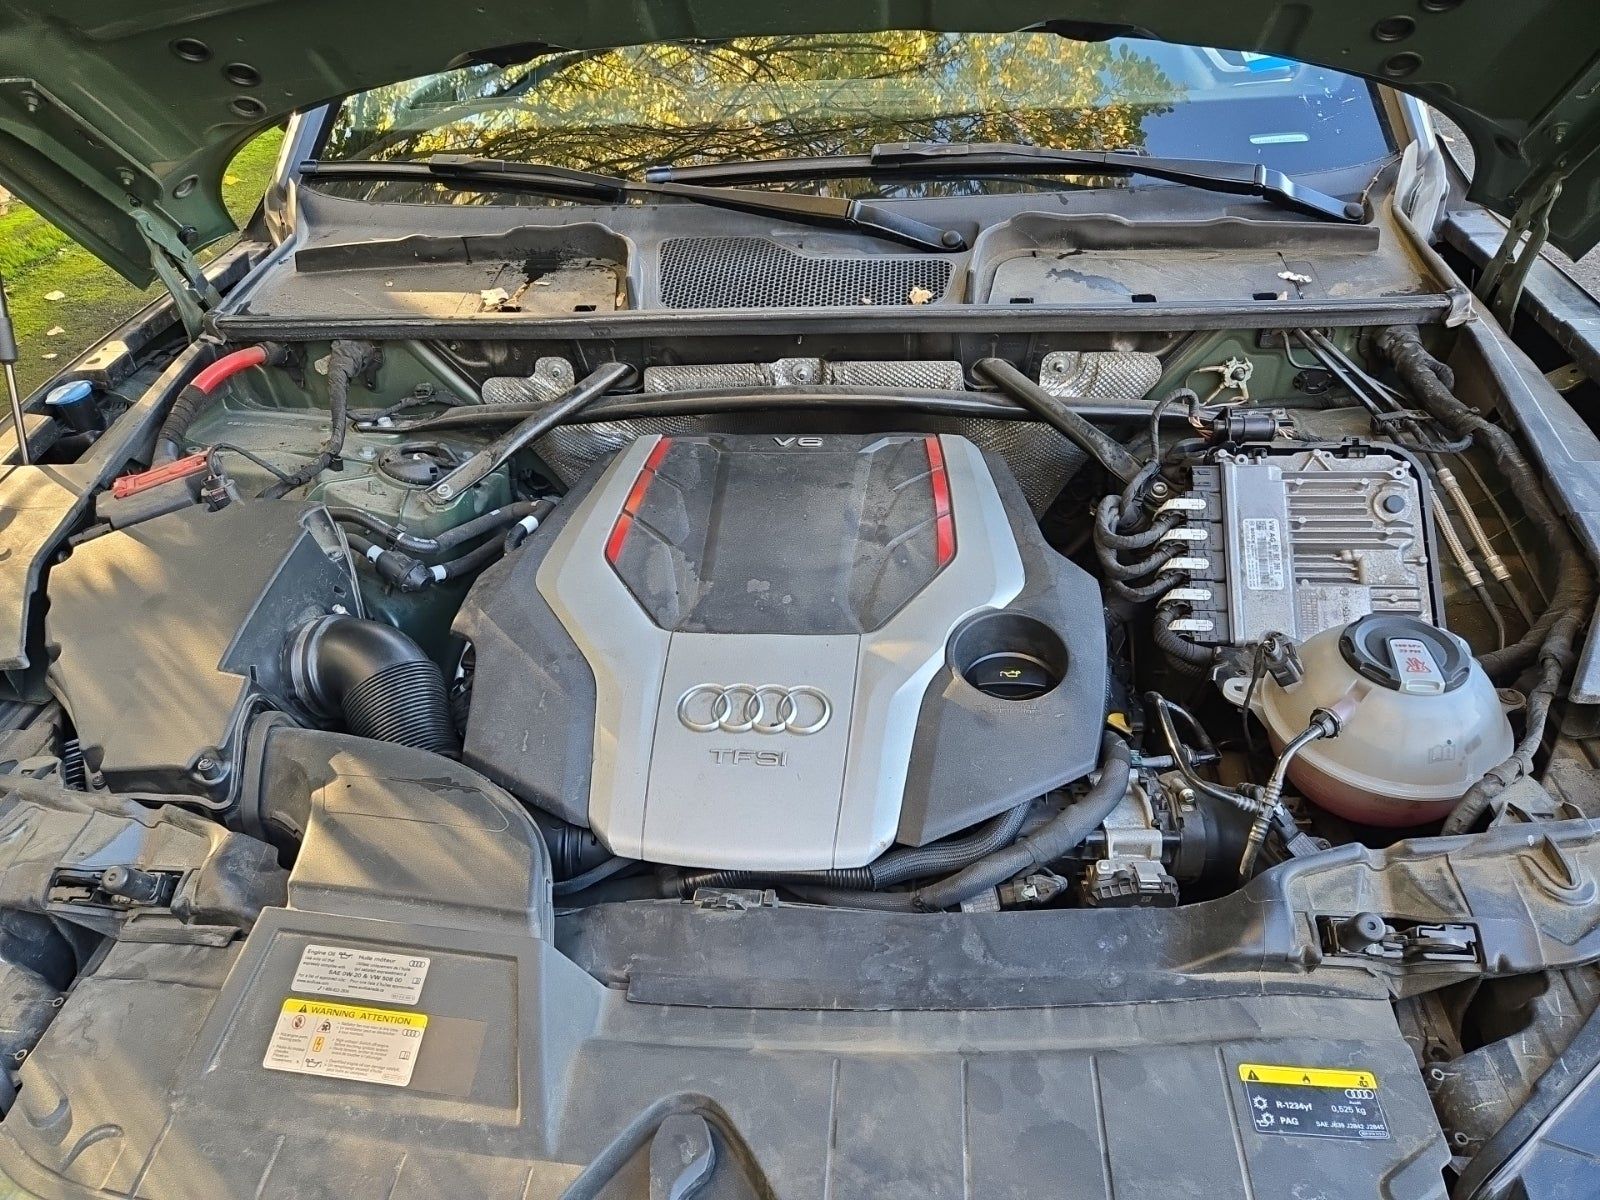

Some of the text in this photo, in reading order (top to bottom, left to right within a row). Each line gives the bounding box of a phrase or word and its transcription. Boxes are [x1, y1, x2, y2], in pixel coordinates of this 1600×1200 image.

[772, 436, 824, 448] V6
[708, 748, 788, 767] TFSI
[310, 1006, 411, 1025] WARNING ATTENTION
[1276, 1100, 1313, 1111] R-1234yf
[1331, 1105, 1366, 1116] 0,525 kg
[1280, 1116, 1299, 1125] PAG
